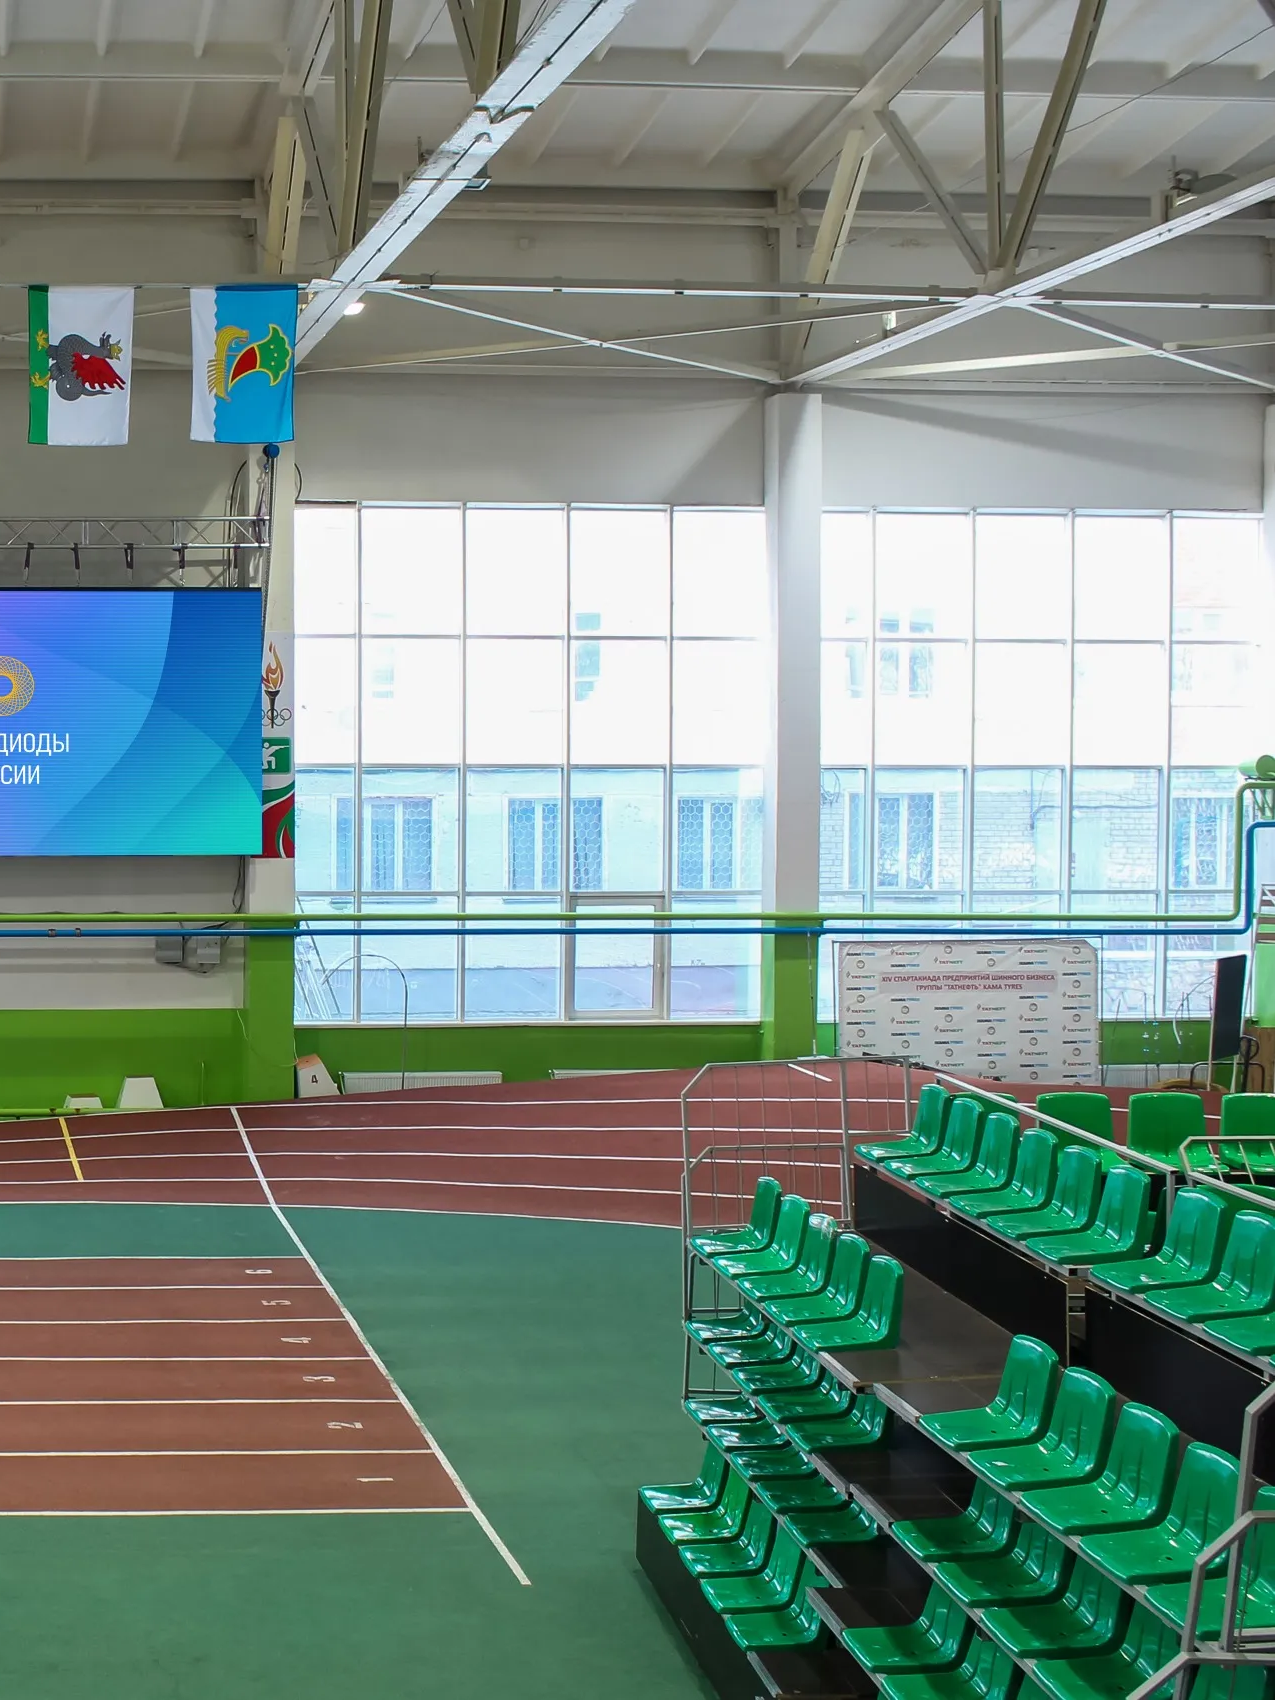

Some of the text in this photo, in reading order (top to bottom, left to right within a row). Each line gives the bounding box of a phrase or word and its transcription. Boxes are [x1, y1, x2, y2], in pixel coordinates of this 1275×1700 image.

[942, 974, 990, 982] ПРЕДПРИЯТИЙ
[311, 1074, 319, 1084] 4
[281, 1336, 312, 1344] 4
[303, 1375, 336, 1383] 3
[326, 1421, 364, 1430] 2
